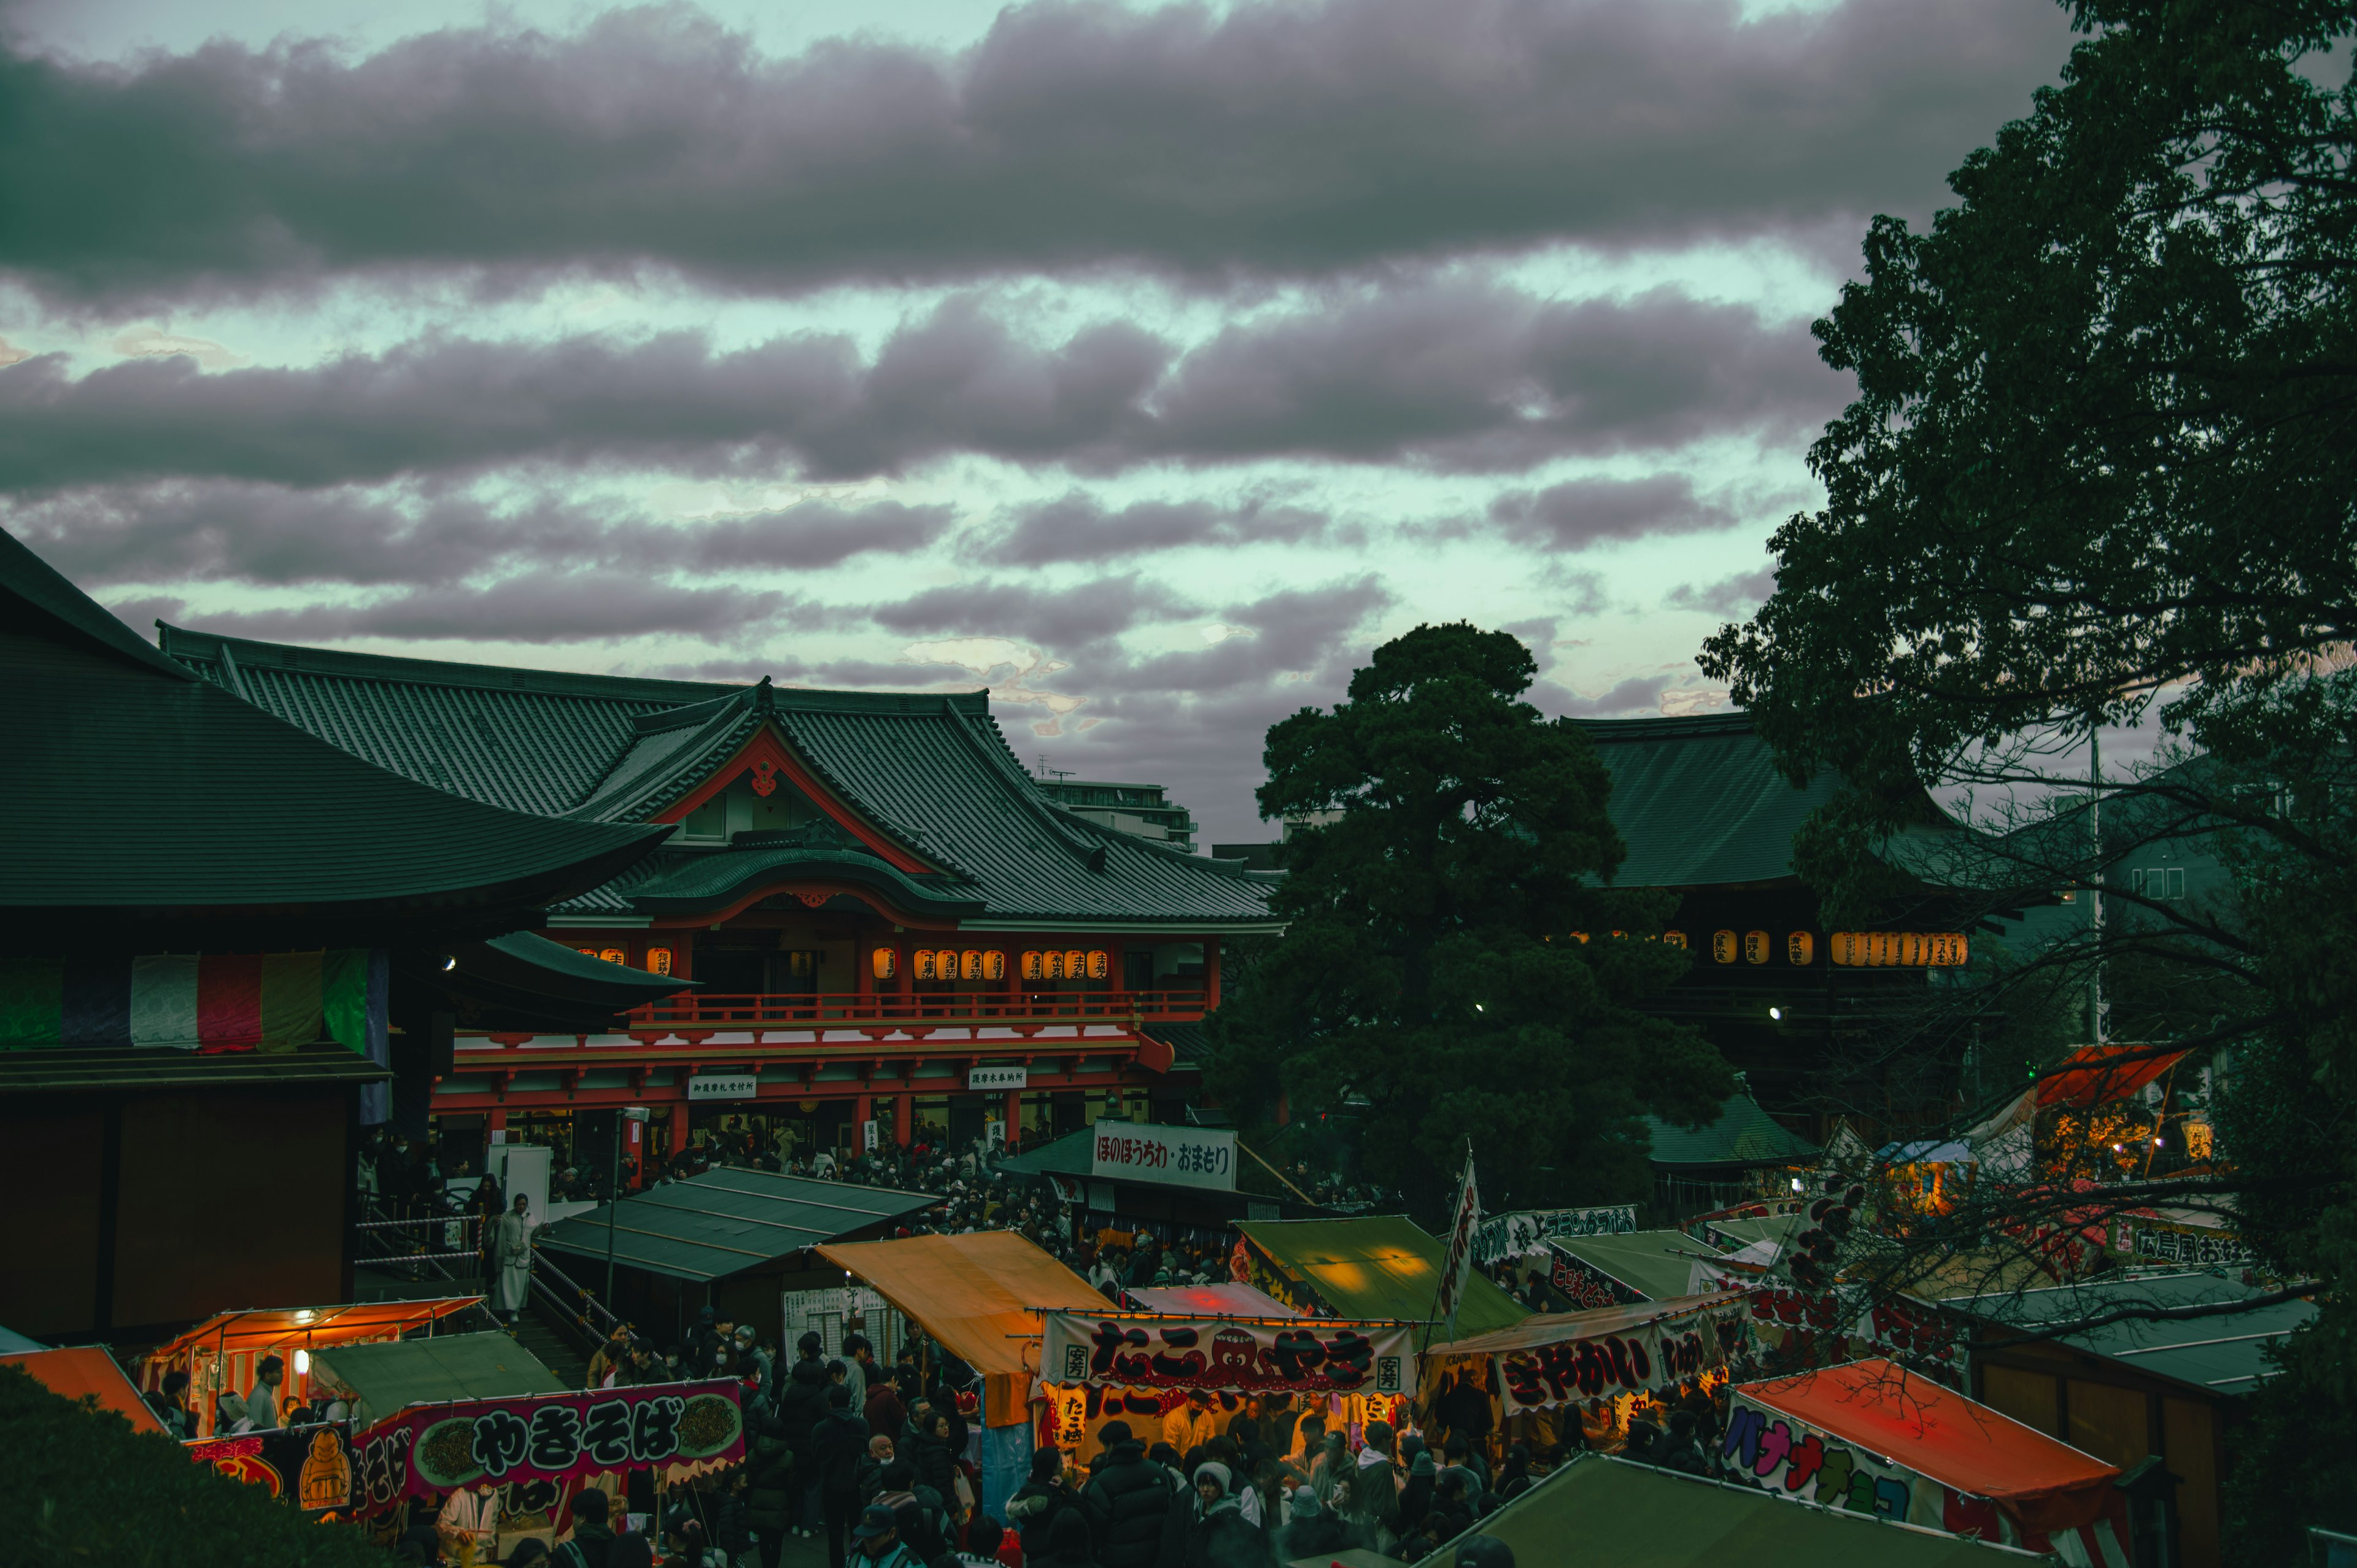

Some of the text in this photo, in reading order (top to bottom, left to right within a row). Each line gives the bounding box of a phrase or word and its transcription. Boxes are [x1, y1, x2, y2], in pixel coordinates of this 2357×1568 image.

[692, 1081, 755, 1093] 御護摩札受付所
[972, 1072, 1024, 1084] 護摩木奉納所
[1097, 1135, 1229, 1175] ほのほうちわ・おまもり
[1090, 1321, 1375, 1383] たこやき
[472, 1395, 687, 1477] やきそば
